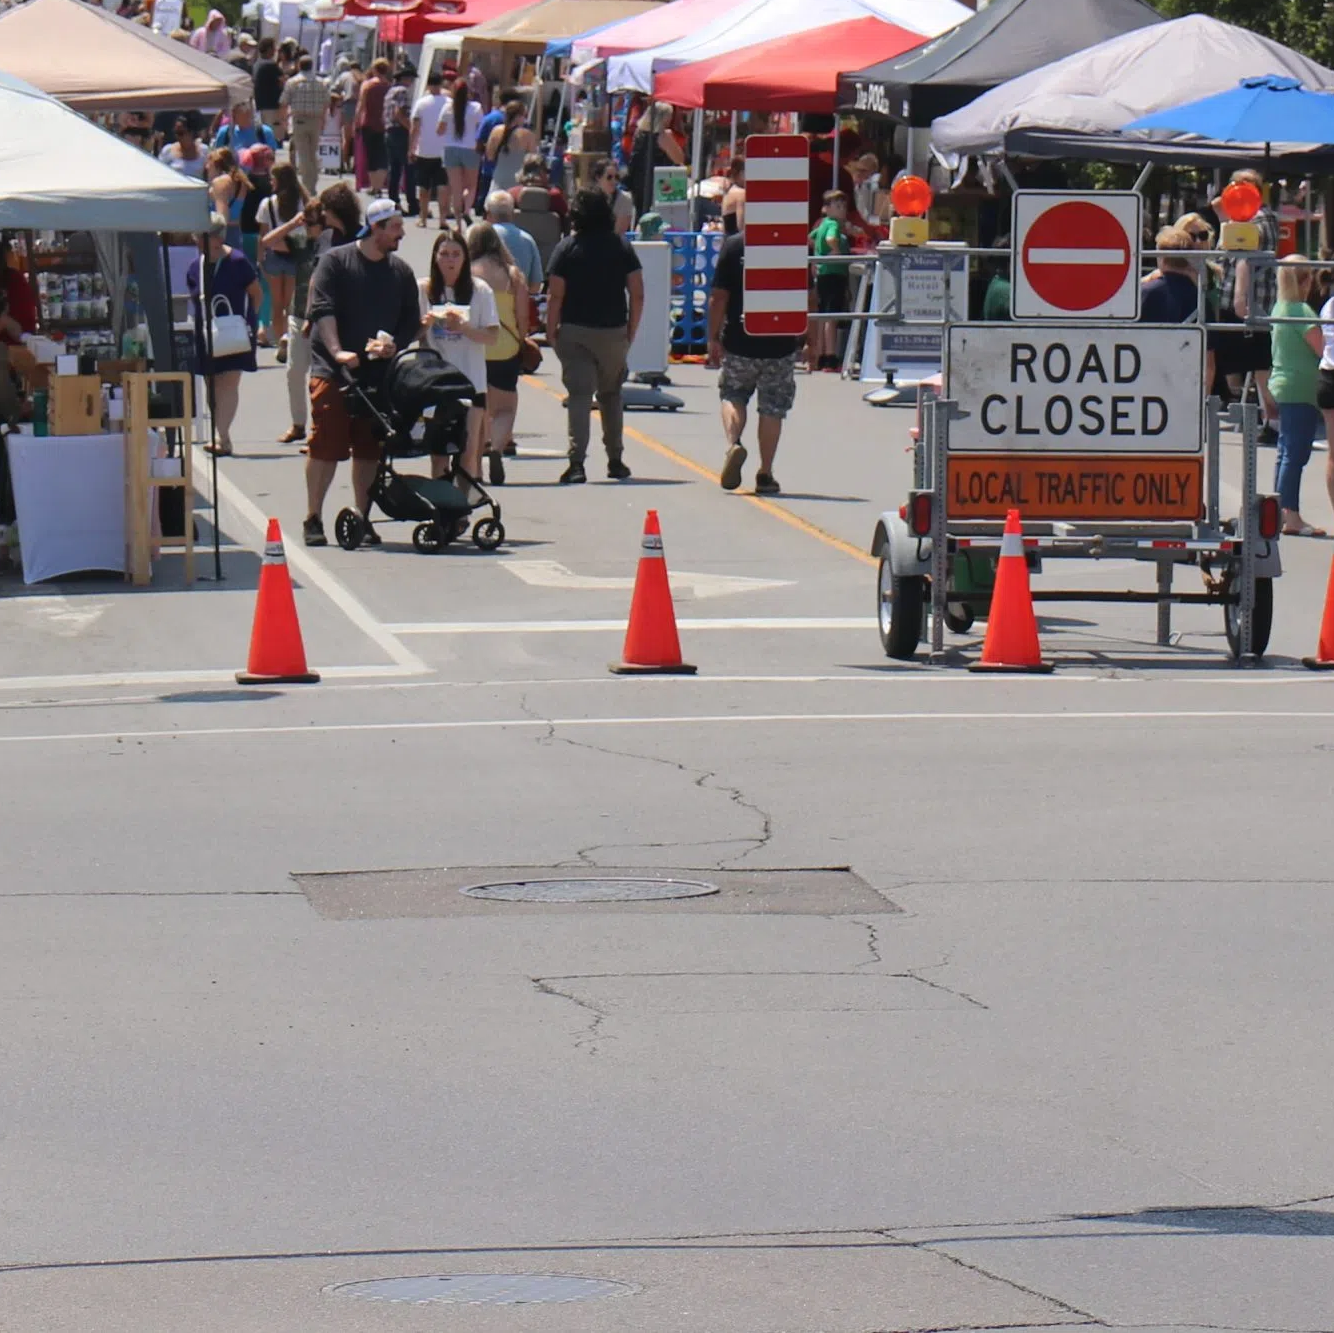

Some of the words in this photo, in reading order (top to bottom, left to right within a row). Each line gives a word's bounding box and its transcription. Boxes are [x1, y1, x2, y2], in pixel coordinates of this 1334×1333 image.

[1010, 342, 1141, 384] ROAD
[980, 393, 1169, 436] CLOSED
[955, 471, 1029, 504] LOCAL
[1034, 471, 1125, 505] TRAFFIC
[1132, 472, 1191, 505] ONLY
